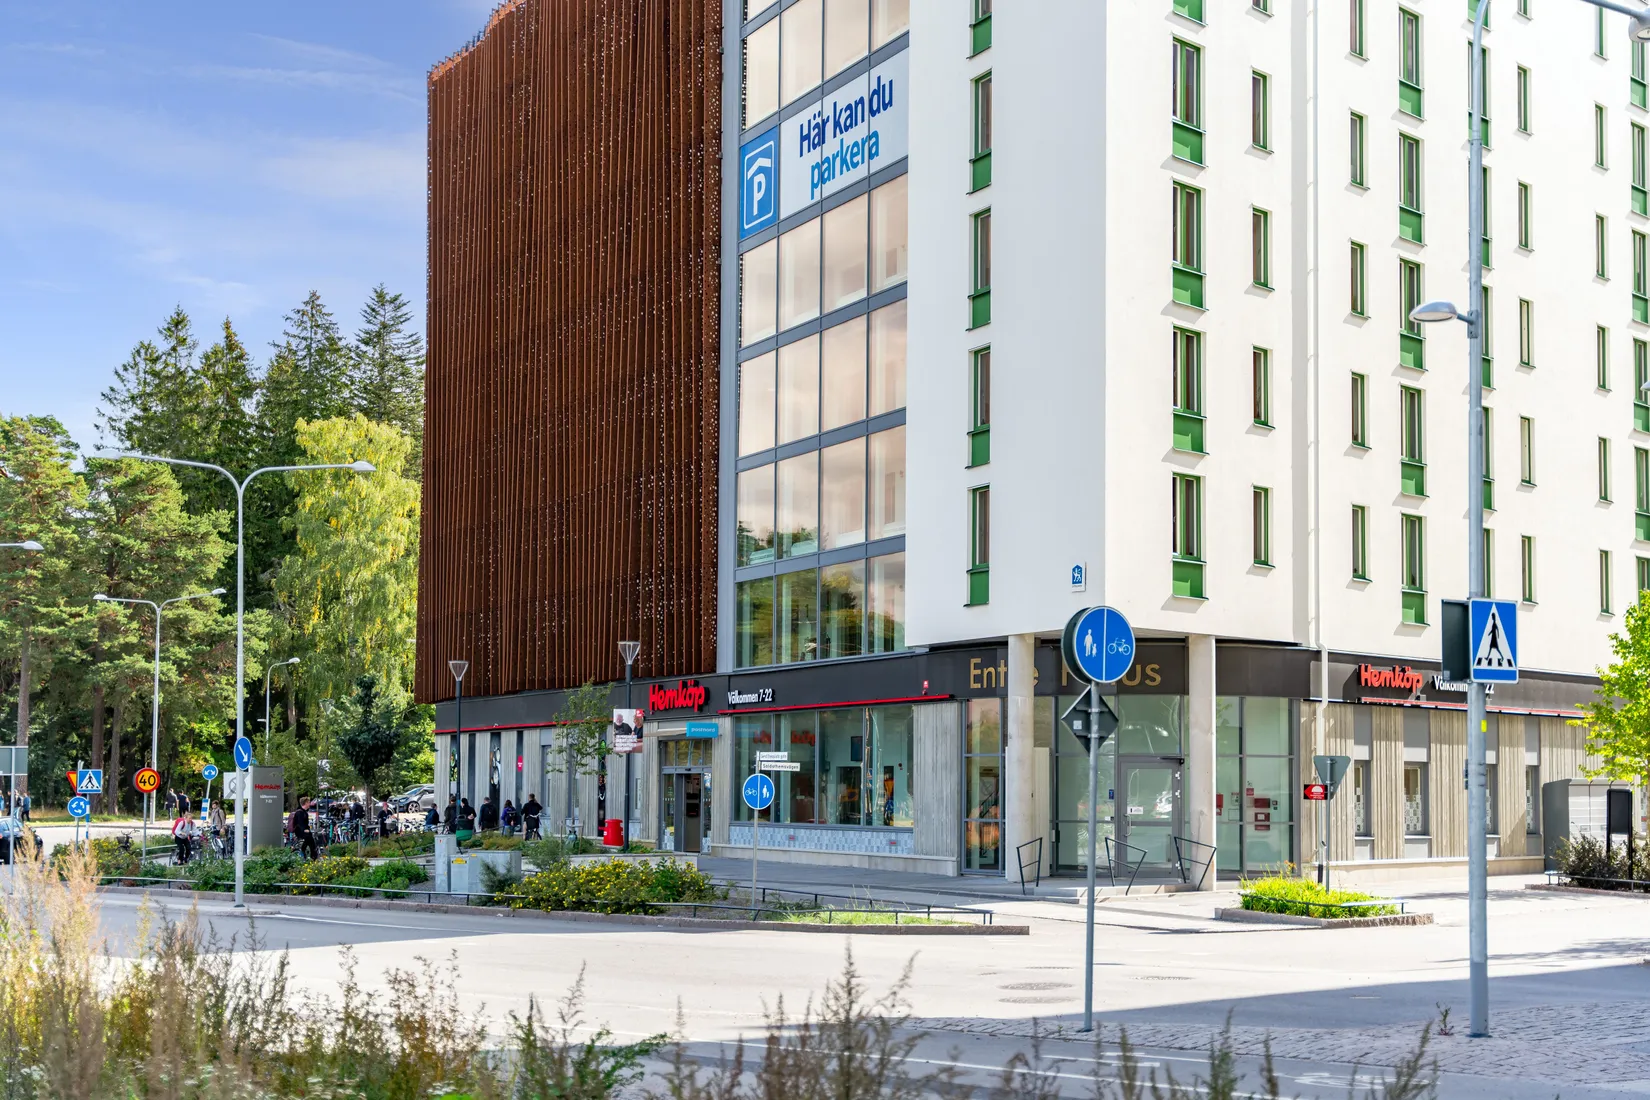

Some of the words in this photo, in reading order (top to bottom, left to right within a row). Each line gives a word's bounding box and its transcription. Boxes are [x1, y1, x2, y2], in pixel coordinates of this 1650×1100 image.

[800, 110, 830, 158] Här
[832, 100, 865, 139] kan
[869, 75, 893, 118] du
[810, 130, 880, 201] parkera
[1360, 663, 1423, 694] Hemköp
[649, 679, 706, 713] Hemköp
[727, 689, 759, 705] Välkommen
[759, 688, 773, 702] 7-22
[138, 774, 156, 787] 40
